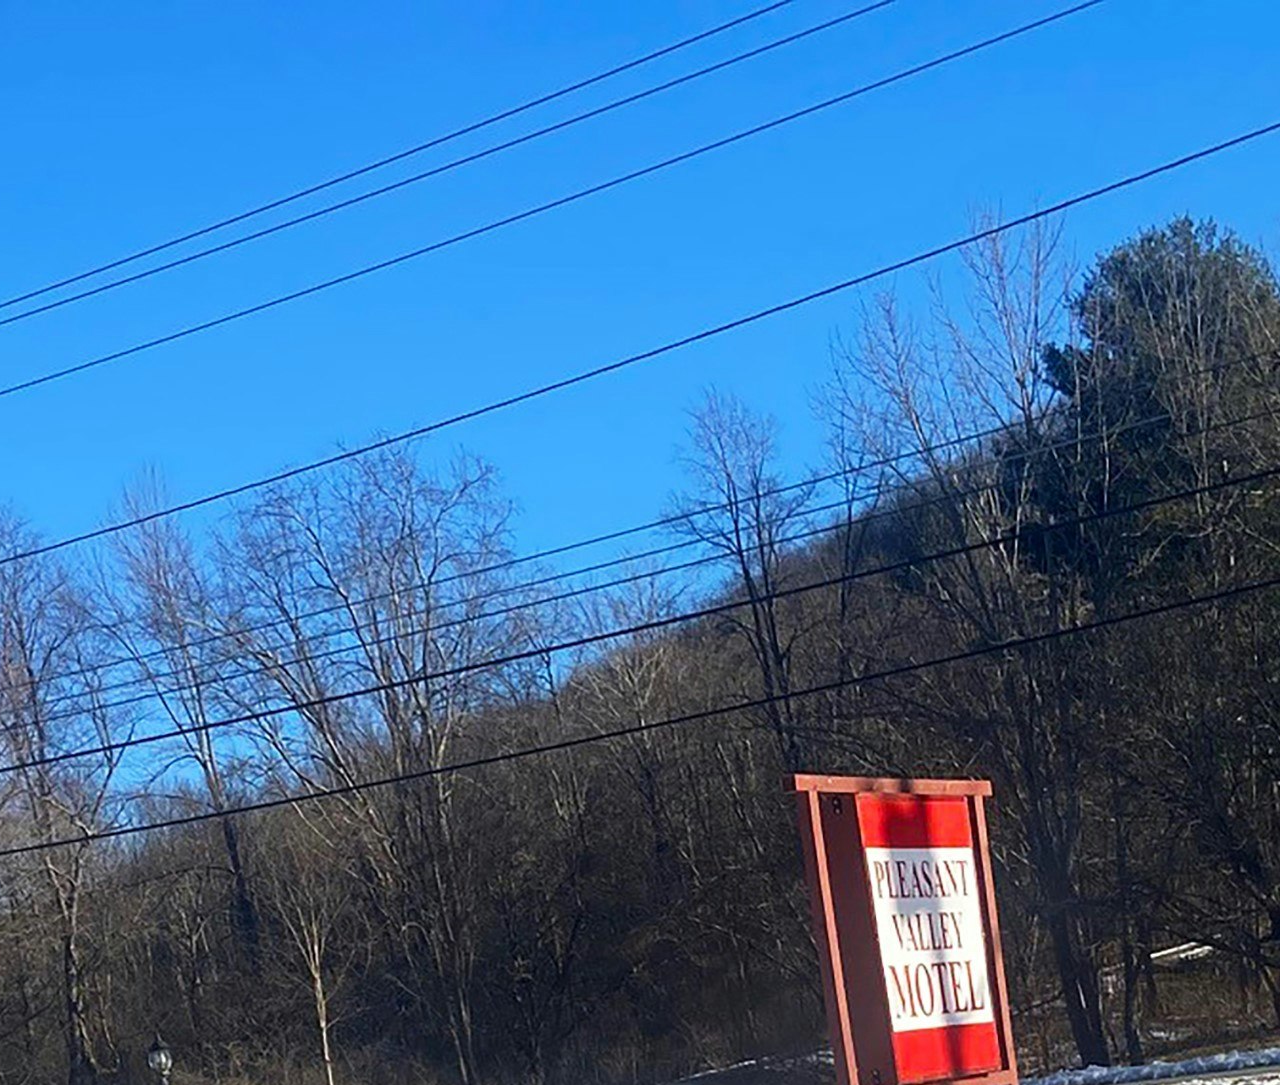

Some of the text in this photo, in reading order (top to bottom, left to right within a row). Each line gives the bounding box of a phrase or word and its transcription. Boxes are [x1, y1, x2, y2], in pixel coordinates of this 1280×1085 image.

[873, 860, 968, 899] PLEASANT
[892, 912, 963, 951] VALLEY
[888, 960, 985, 1018] MOTEL
